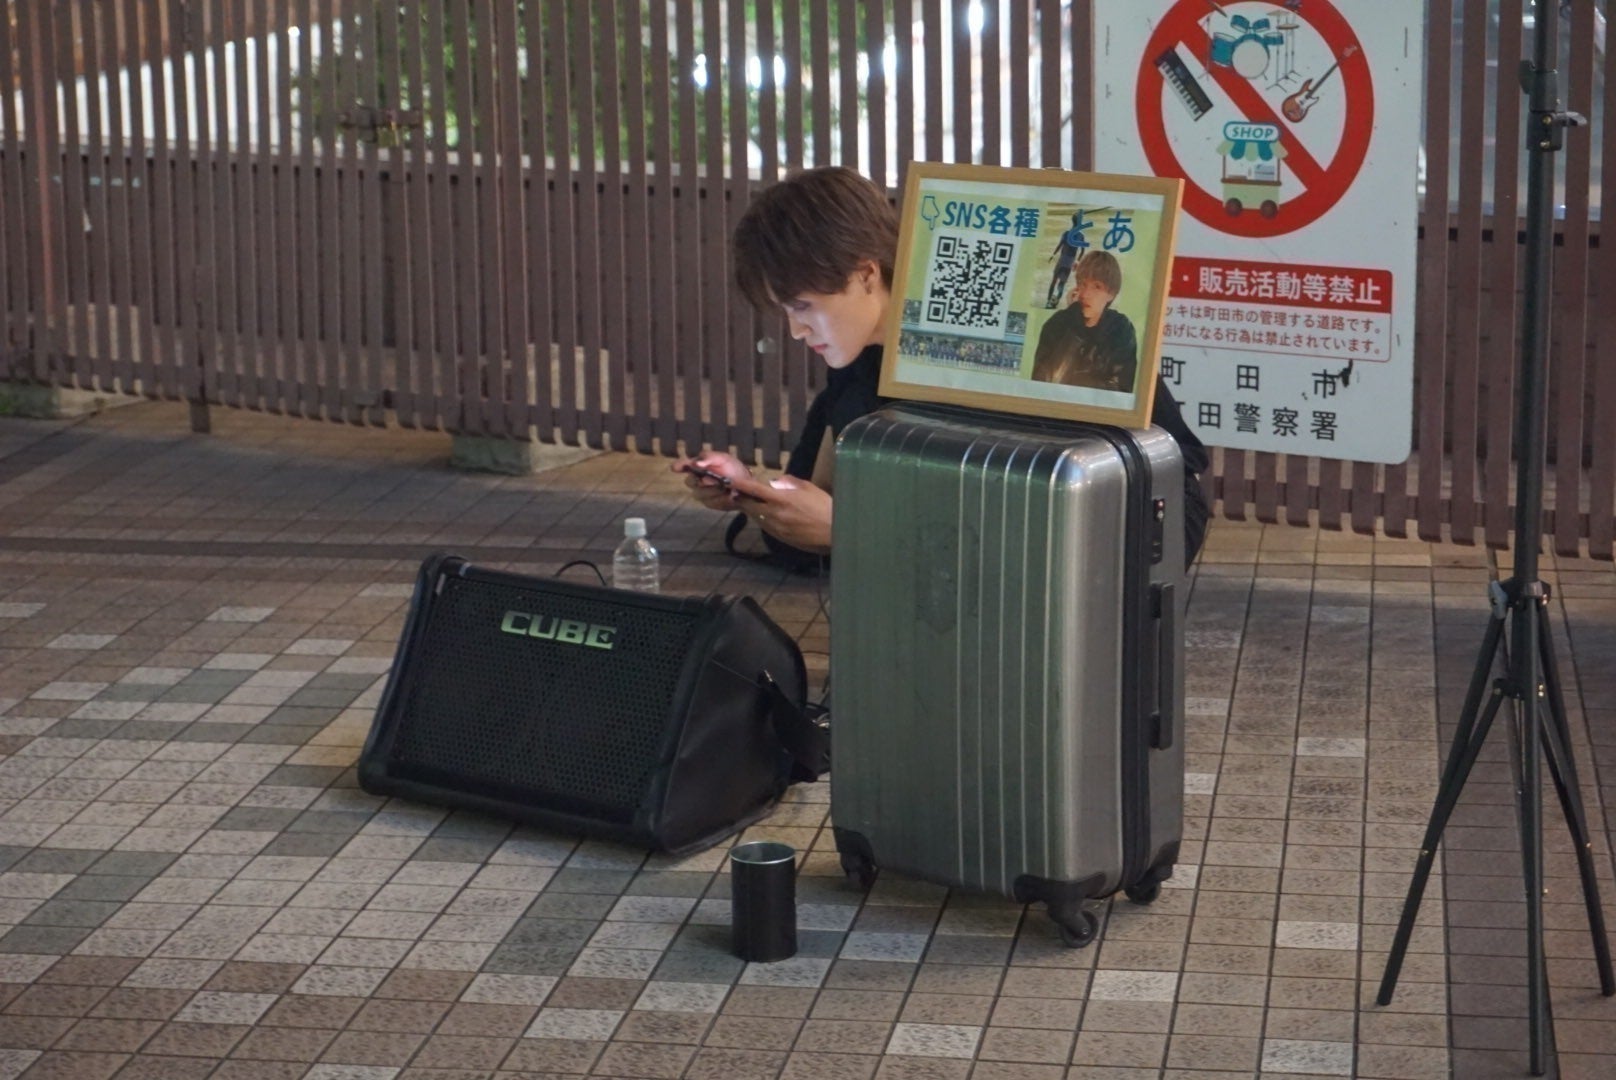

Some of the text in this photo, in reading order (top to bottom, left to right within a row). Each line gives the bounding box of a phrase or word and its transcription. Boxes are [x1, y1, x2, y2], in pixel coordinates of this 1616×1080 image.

[1232, 126, 1274, 138] SHOP
[942, 200, 1040, 238] SNS各種
[1175, 401, 1338, 441] 田警察署
[500, 610, 617, 650] CUBE
